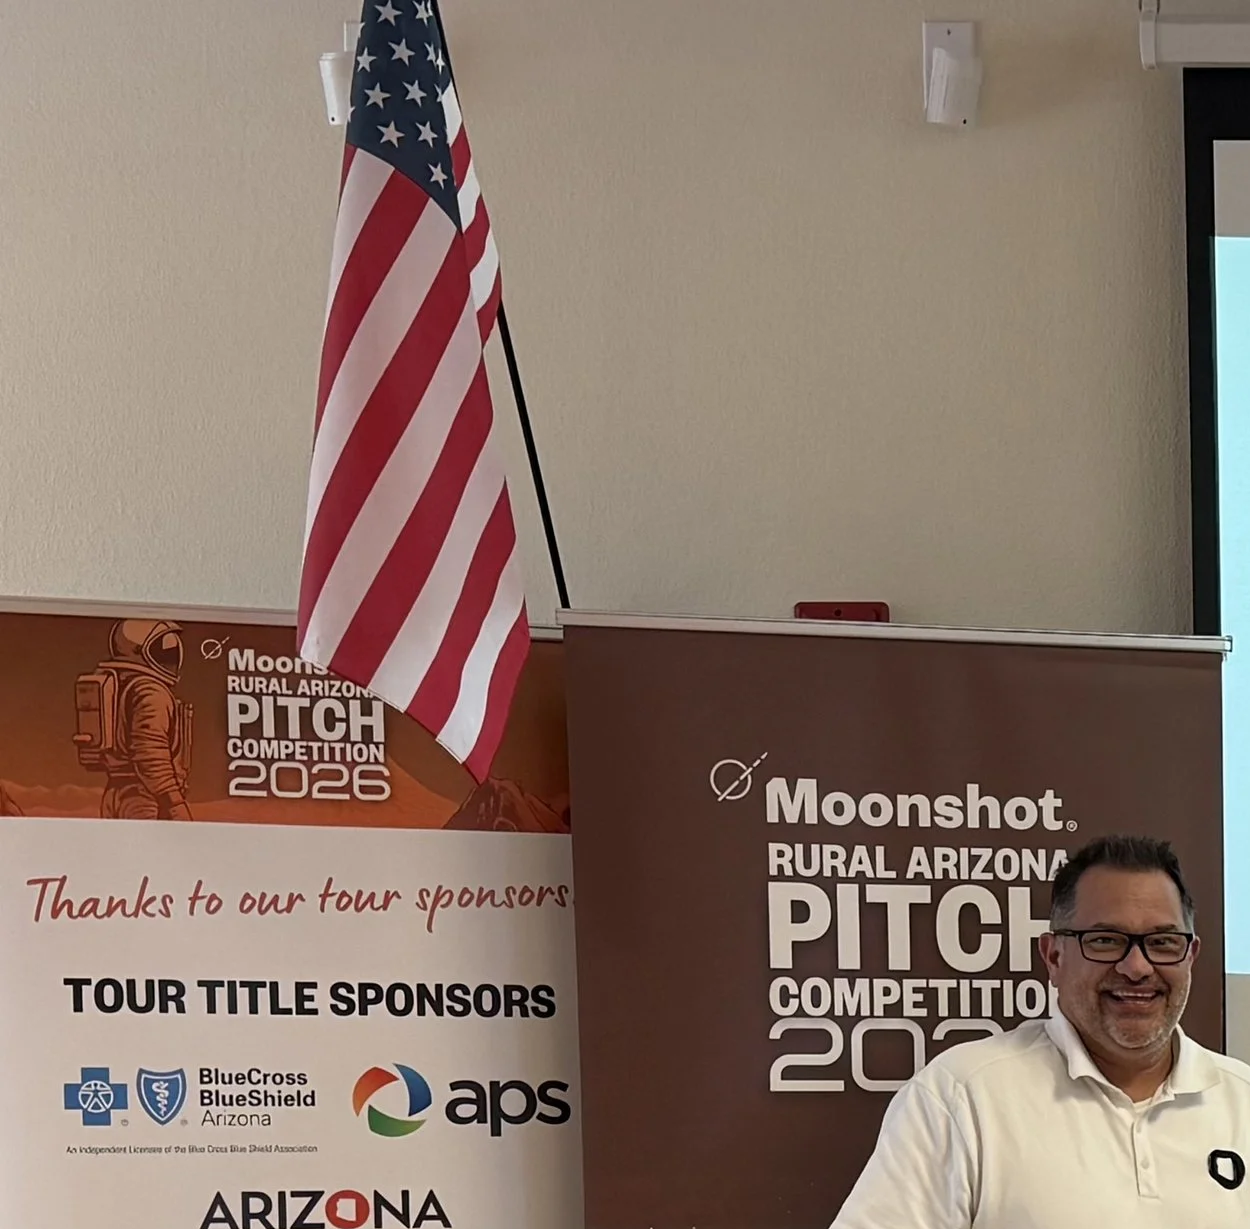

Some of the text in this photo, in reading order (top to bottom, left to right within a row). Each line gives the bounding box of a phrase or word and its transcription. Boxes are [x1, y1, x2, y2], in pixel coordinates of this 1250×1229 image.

[228, 675, 381, 698] RURAL ARIZON
[227, 694, 385, 742] PITCH
[227, 738, 385, 763] COMPETITION
[228, 759, 391, 801] 2026
[766, 777, 1064, 831] Moonshot
[768, 843, 1069, 881] RURAL ARIZONA
[27, 875, 569, 933] Thanks to our tour sponsors
[63, 977, 557, 1019] TOUR TITLE SPONSORS
[199, 1068, 308, 1086] BlueCross
[200, 1089, 316, 1107] BlueShield
[201, 1109, 272, 1127] Arizona
[445, 1080, 571, 1137] aps
